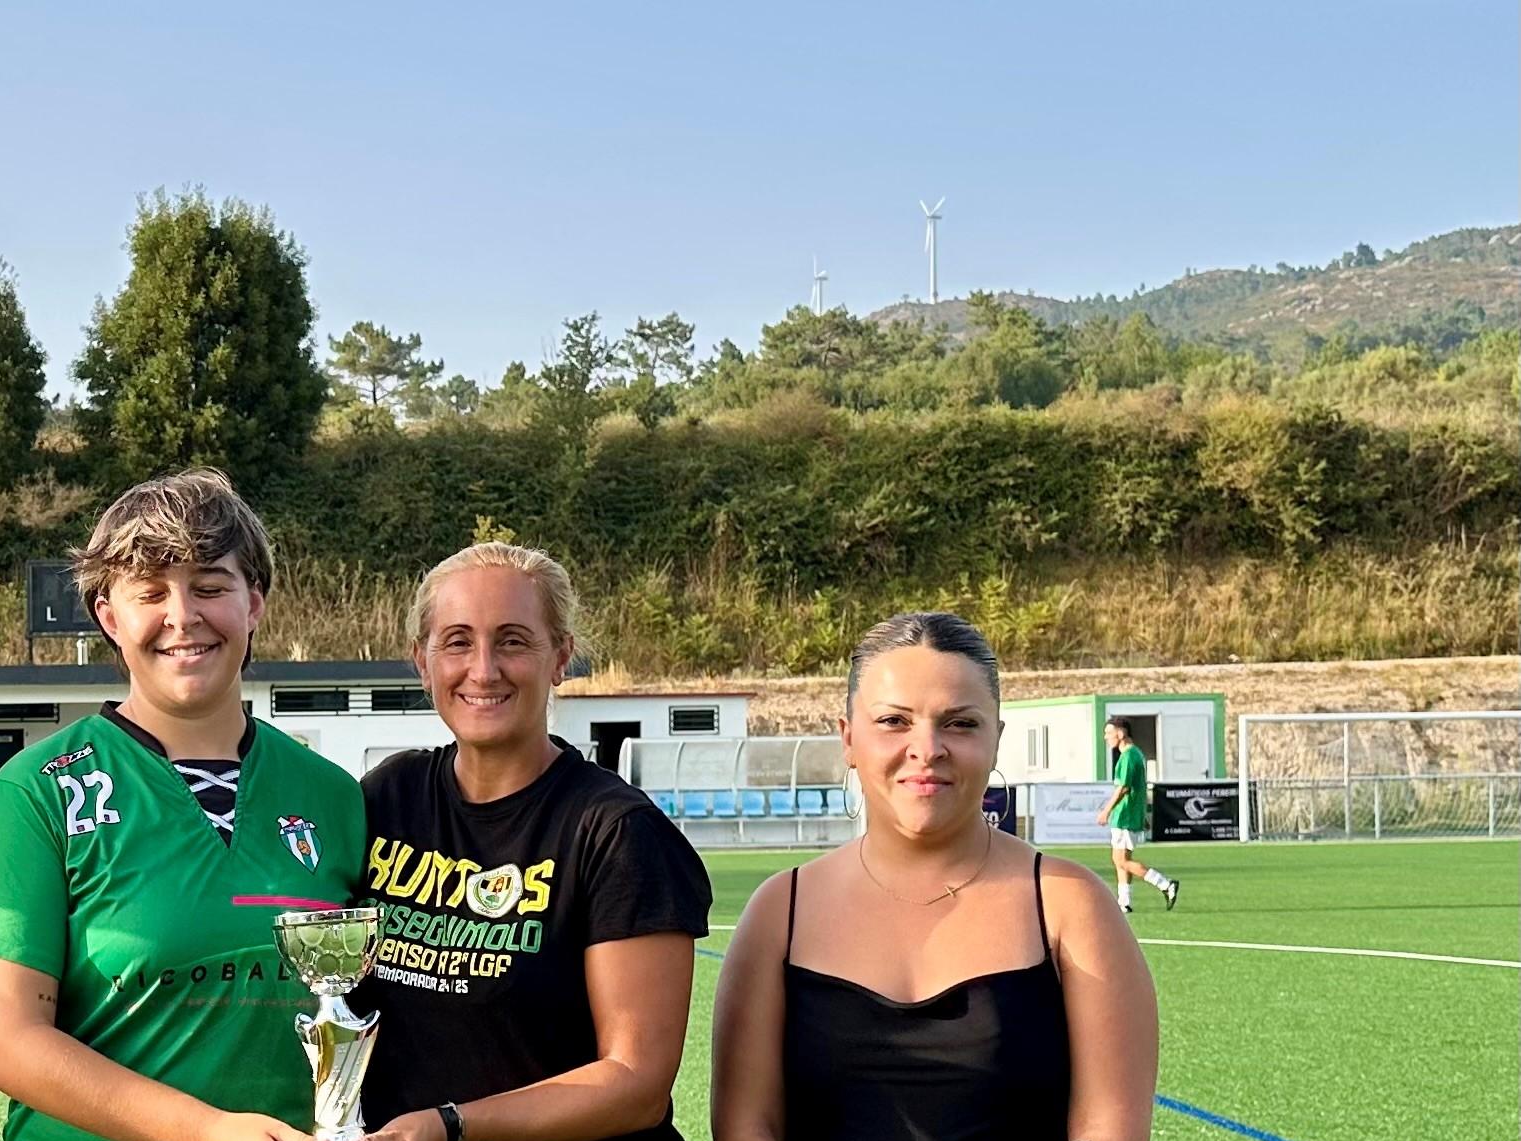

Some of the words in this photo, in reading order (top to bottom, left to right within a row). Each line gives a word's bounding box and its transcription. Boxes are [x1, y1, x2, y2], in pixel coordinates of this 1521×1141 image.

[46, 606, 57, 622] L
[57, 770, 121, 837] 22
[469, 952, 512, 978] LGF
